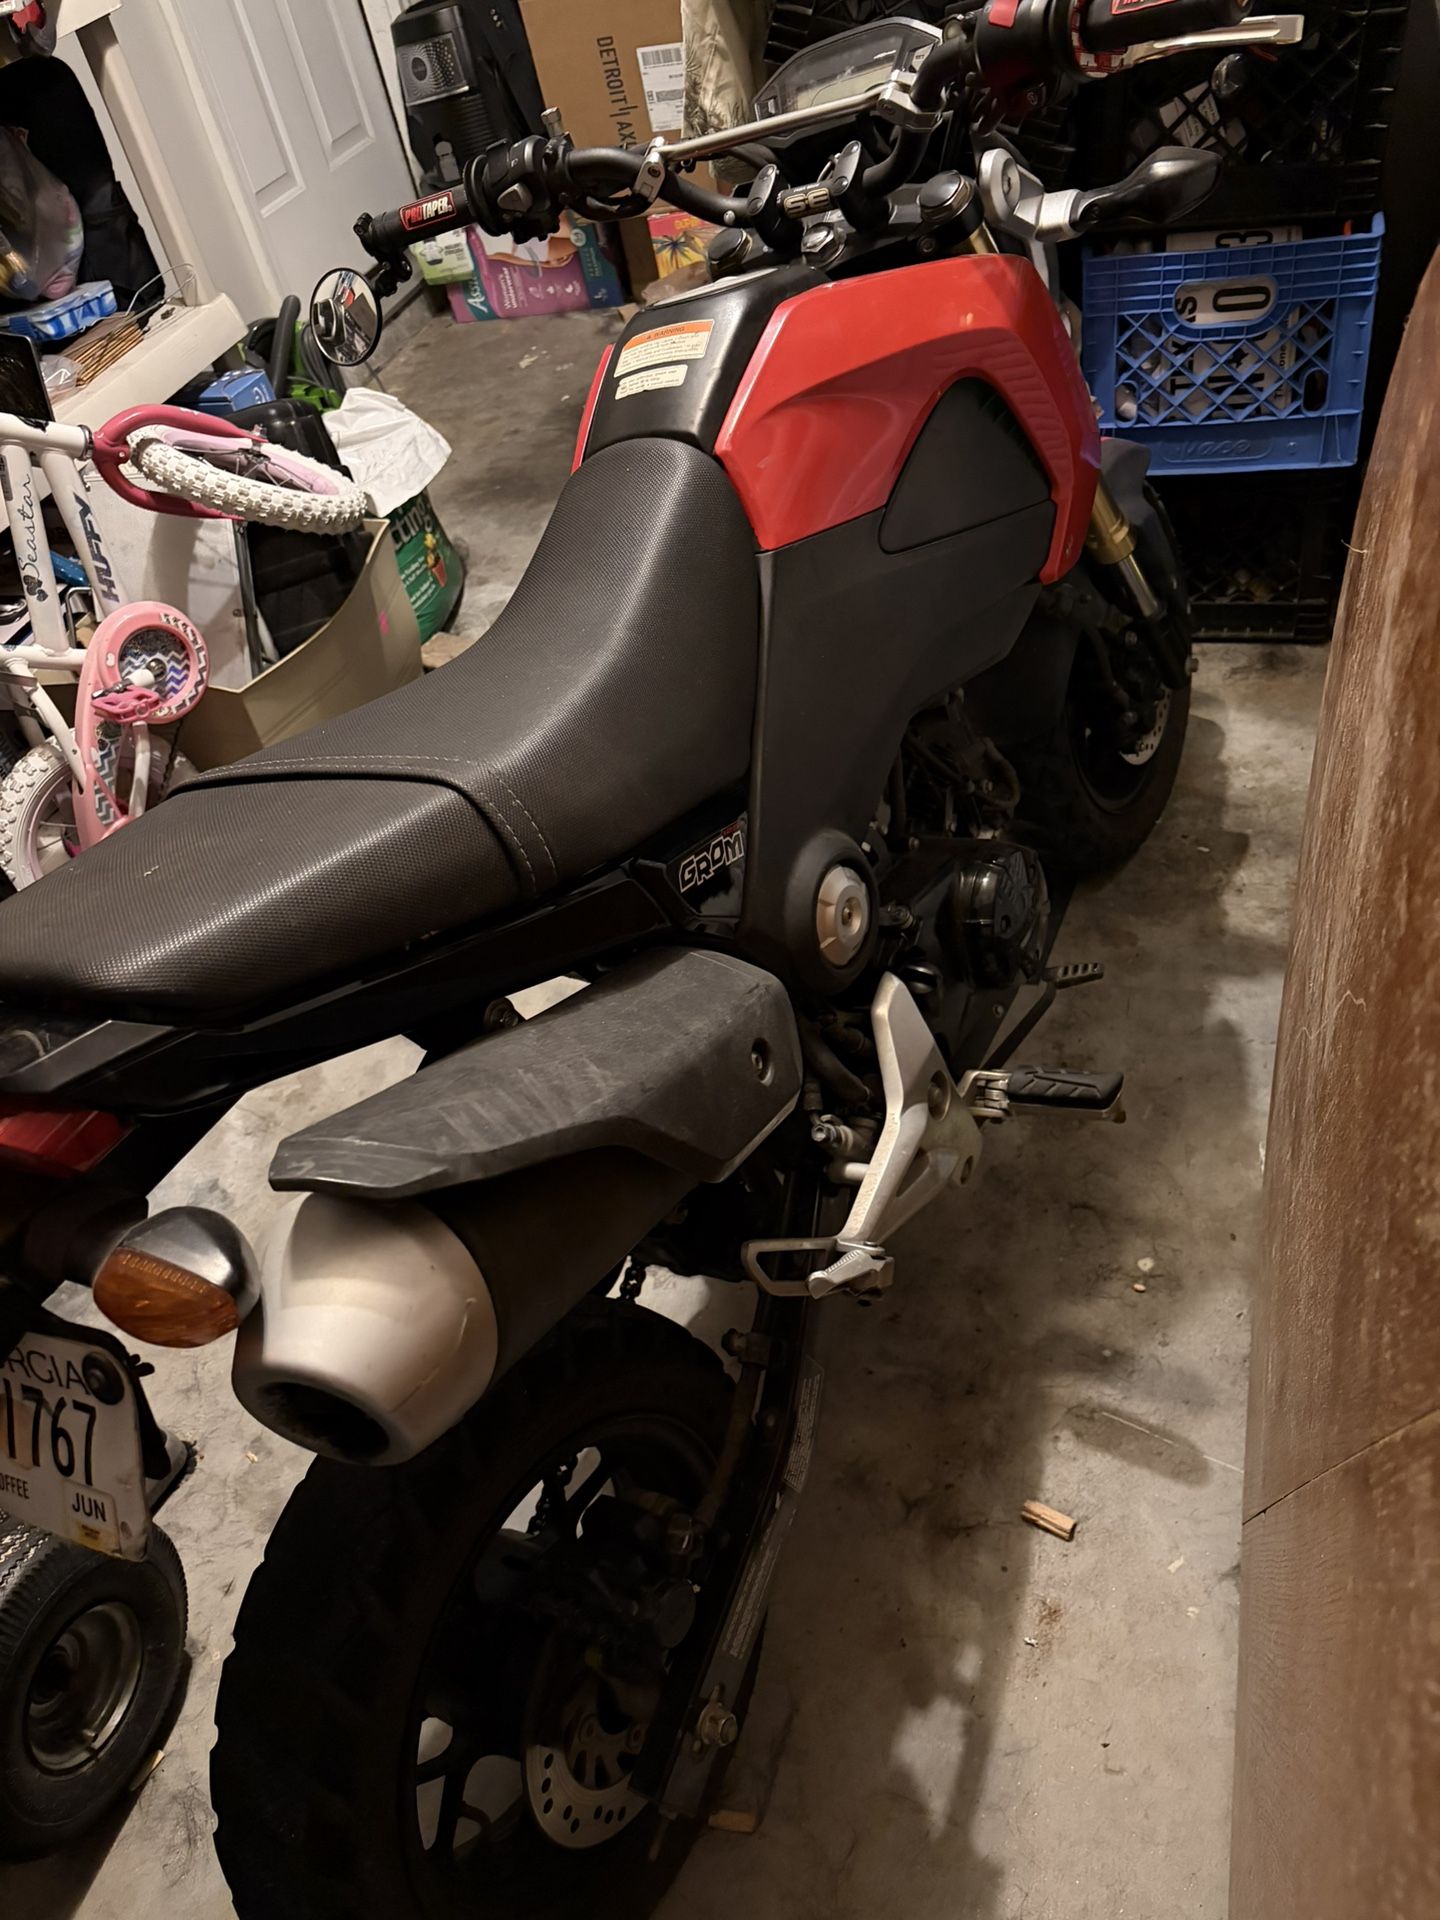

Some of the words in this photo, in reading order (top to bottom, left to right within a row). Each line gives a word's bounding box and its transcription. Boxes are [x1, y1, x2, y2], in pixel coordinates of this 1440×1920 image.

[596, 35, 628, 106] DETROIT
[73, 492, 120, 603] HUFFY
[679, 830, 744, 893] GROM
[6, 1347, 90, 1395] RGIA
[72, 1493, 106, 1522] JUN
